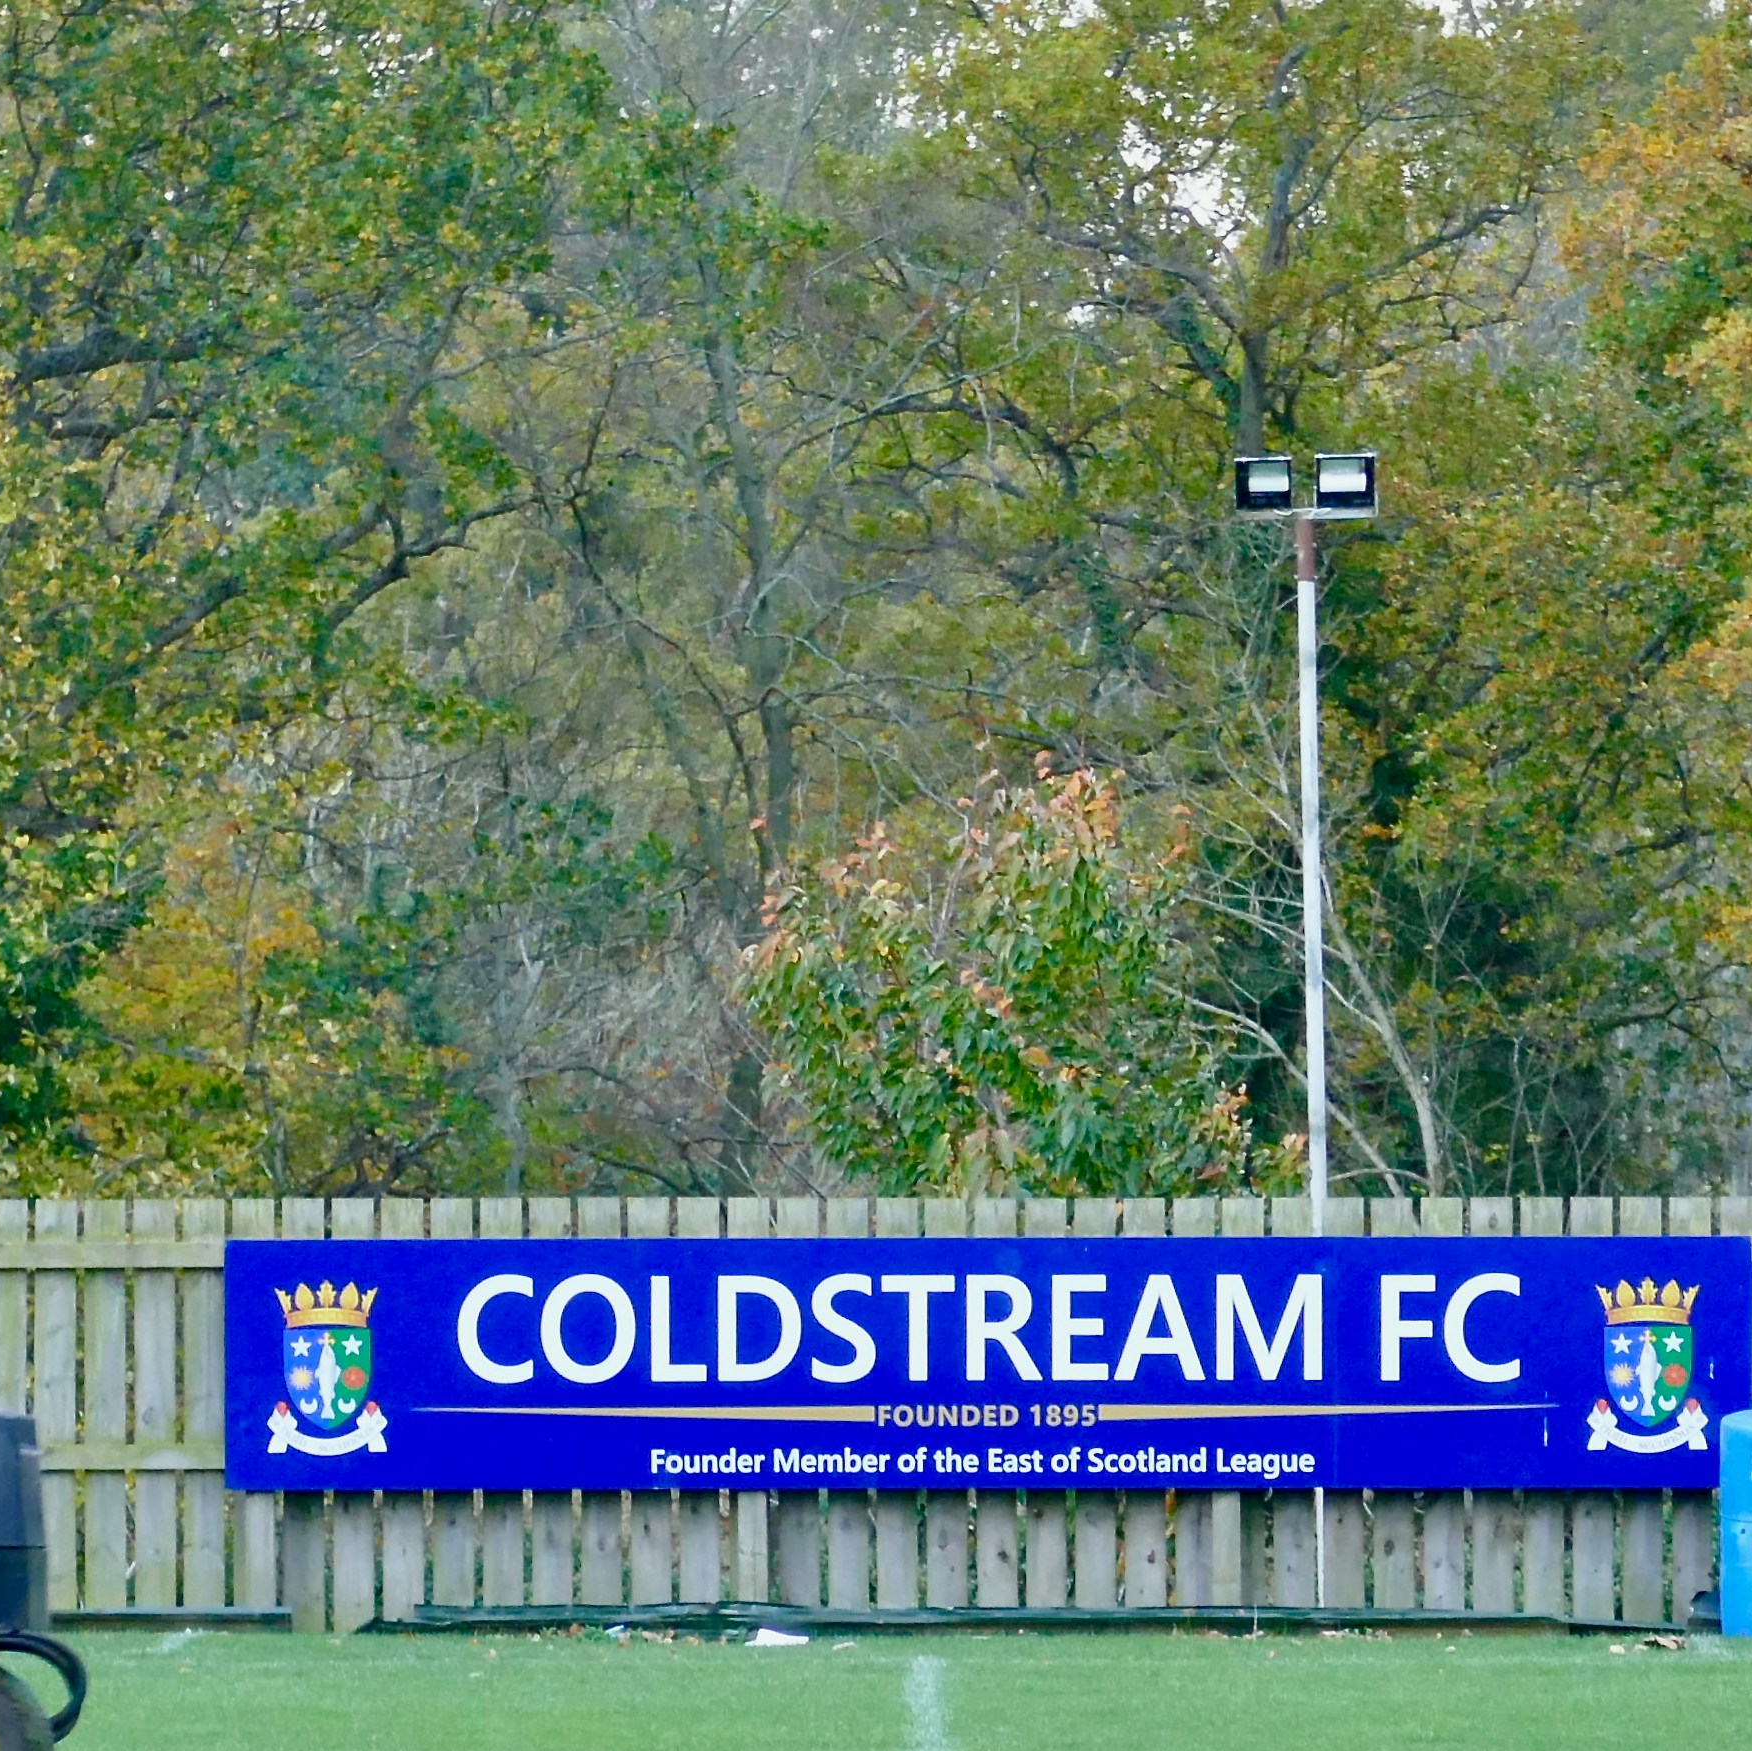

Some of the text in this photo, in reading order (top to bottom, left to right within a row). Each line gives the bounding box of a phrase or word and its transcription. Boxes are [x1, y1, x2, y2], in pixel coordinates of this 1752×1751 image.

[456, 1272, 1522, 1384] COLDSTREAM FC
[876, 1403, 1096, 1428] FOUNDED 1895
[650, 1446, 1316, 1480] Founder Member of the East of Scotland League
